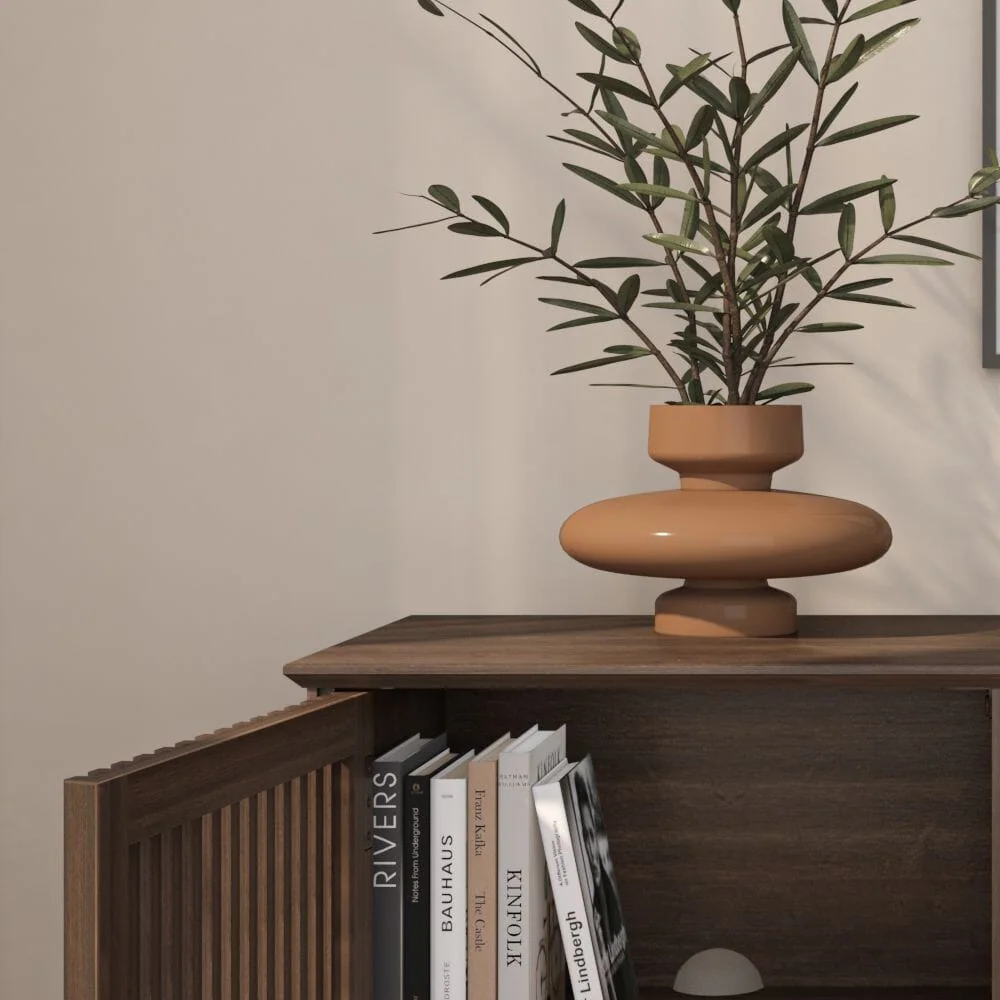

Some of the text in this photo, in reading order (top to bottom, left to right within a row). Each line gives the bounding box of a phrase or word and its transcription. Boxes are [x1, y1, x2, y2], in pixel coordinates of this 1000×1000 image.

[373, 772, 398, 888] RIVERS
[411, 807, 421, 903] Notes From Underground
[474, 789, 486, 857] Franz Kafka
[441, 835, 453, 932] BAUHAUS
[474, 892, 486, 952] The Castle
[506, 869, 522, 967] KINFOLK
[565, 911, 591, 993] Lindbergh
